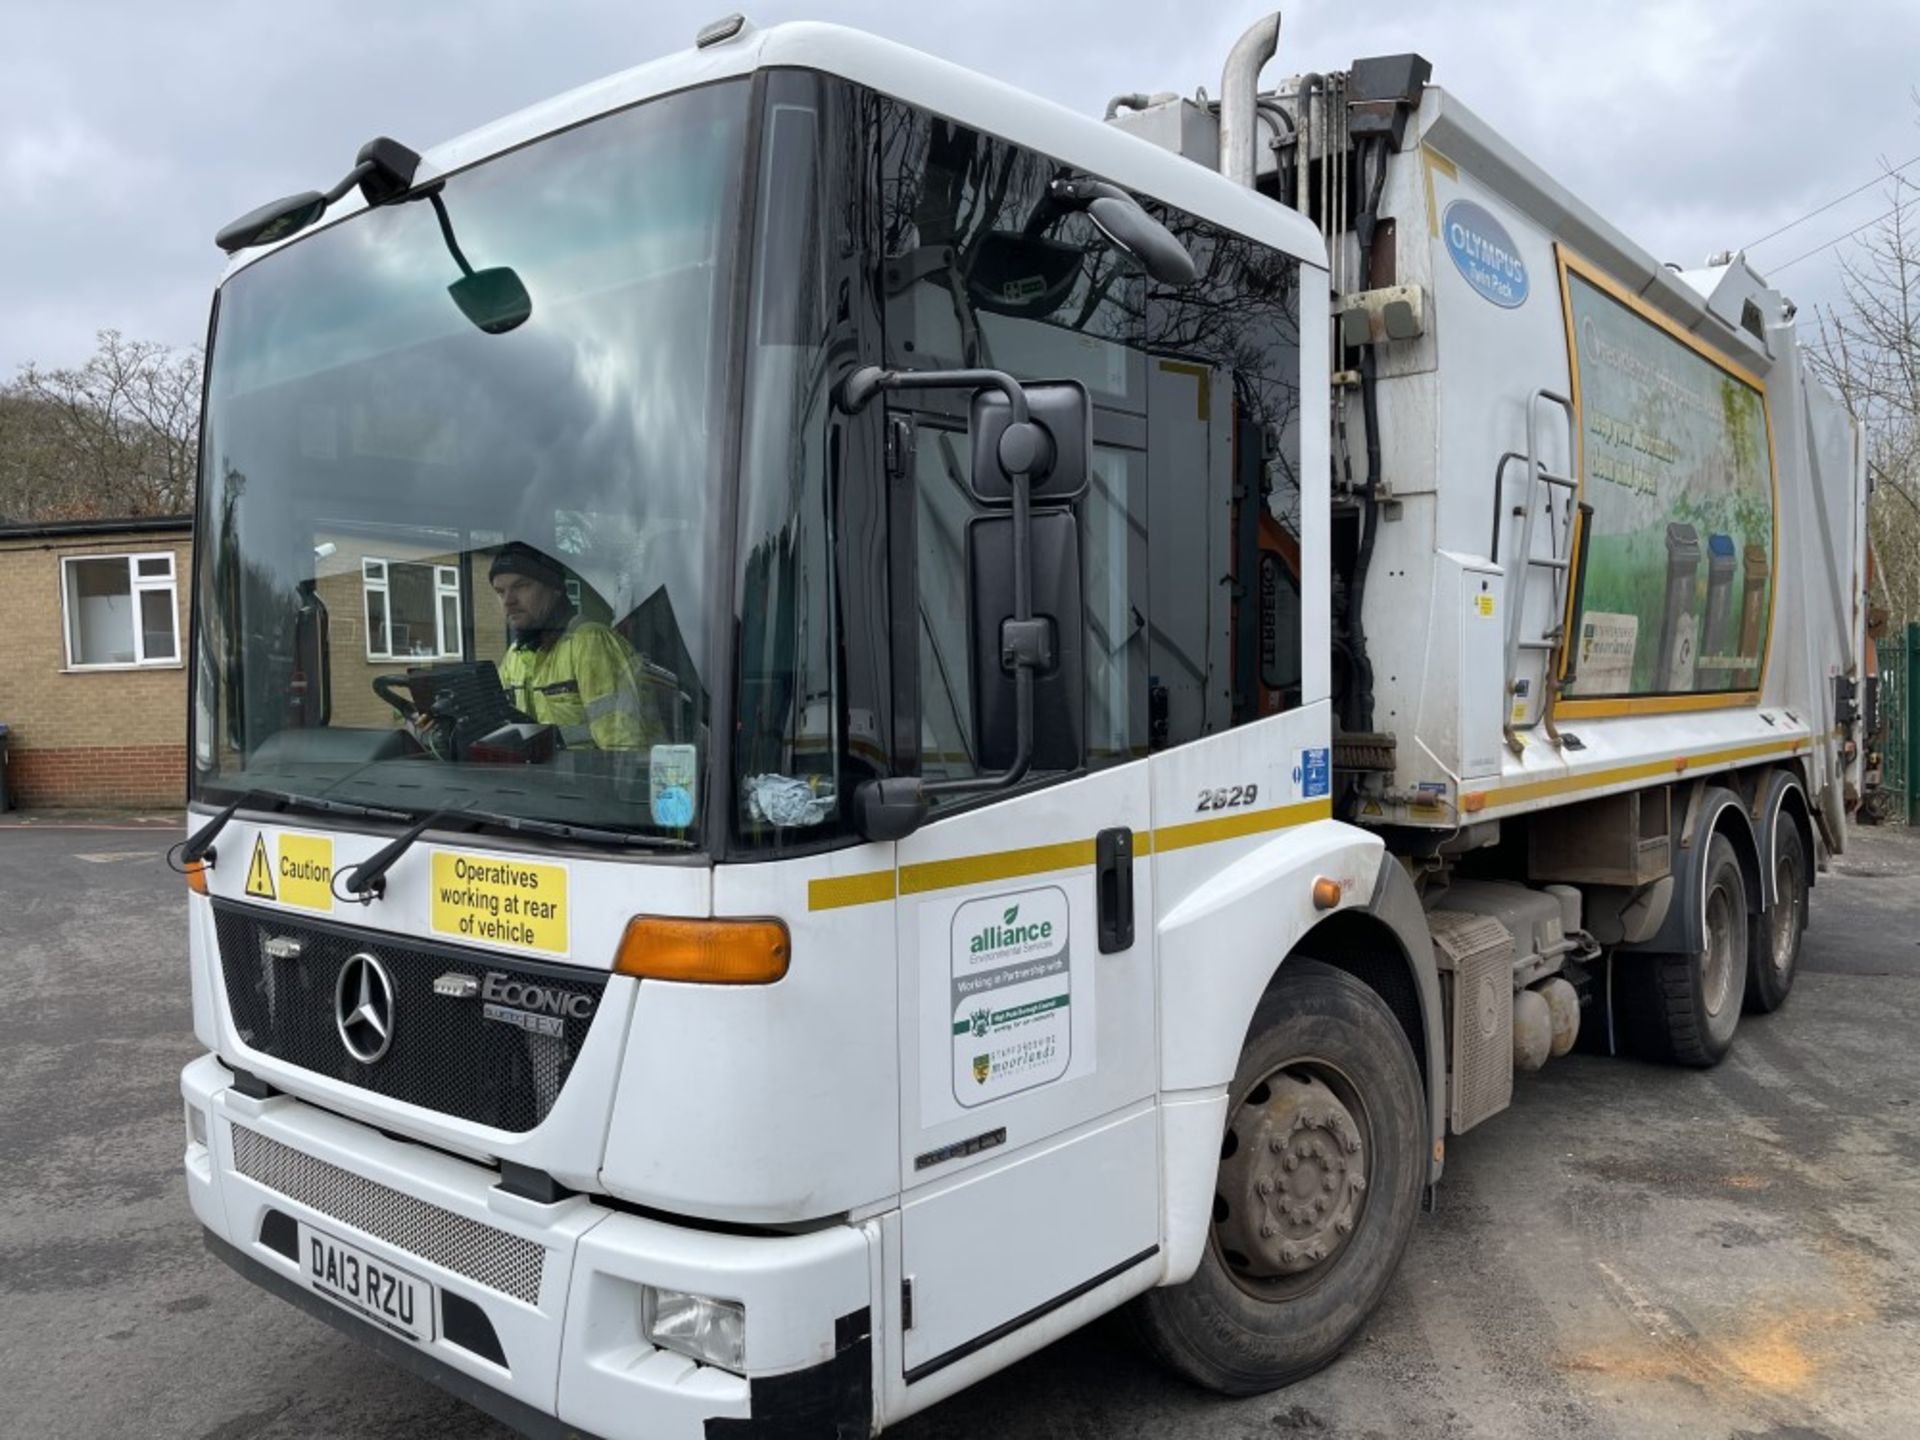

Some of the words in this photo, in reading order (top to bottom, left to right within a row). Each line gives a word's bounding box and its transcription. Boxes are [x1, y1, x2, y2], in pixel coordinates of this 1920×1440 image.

[1451, 223, 1523, 283] OLYMPUS
[1196, 784, 1258, 813] 2629
[280, 856, 331, 882] Caution
[454, 859, 539, 889] Operatives
[440, 887, 500, 916] working
[504, 897, 519, 915] at
[523, 901, 558, 920] rear
[459, 914, 476, 933] of
[478, 919, 535, 945] vehicle
[970, 921, 1052, 953] alliance
[957, 975, 992, 992] Working
[311, 1236, 360, 1297] DA13
[367, 1264, 414, 1325] RZU
